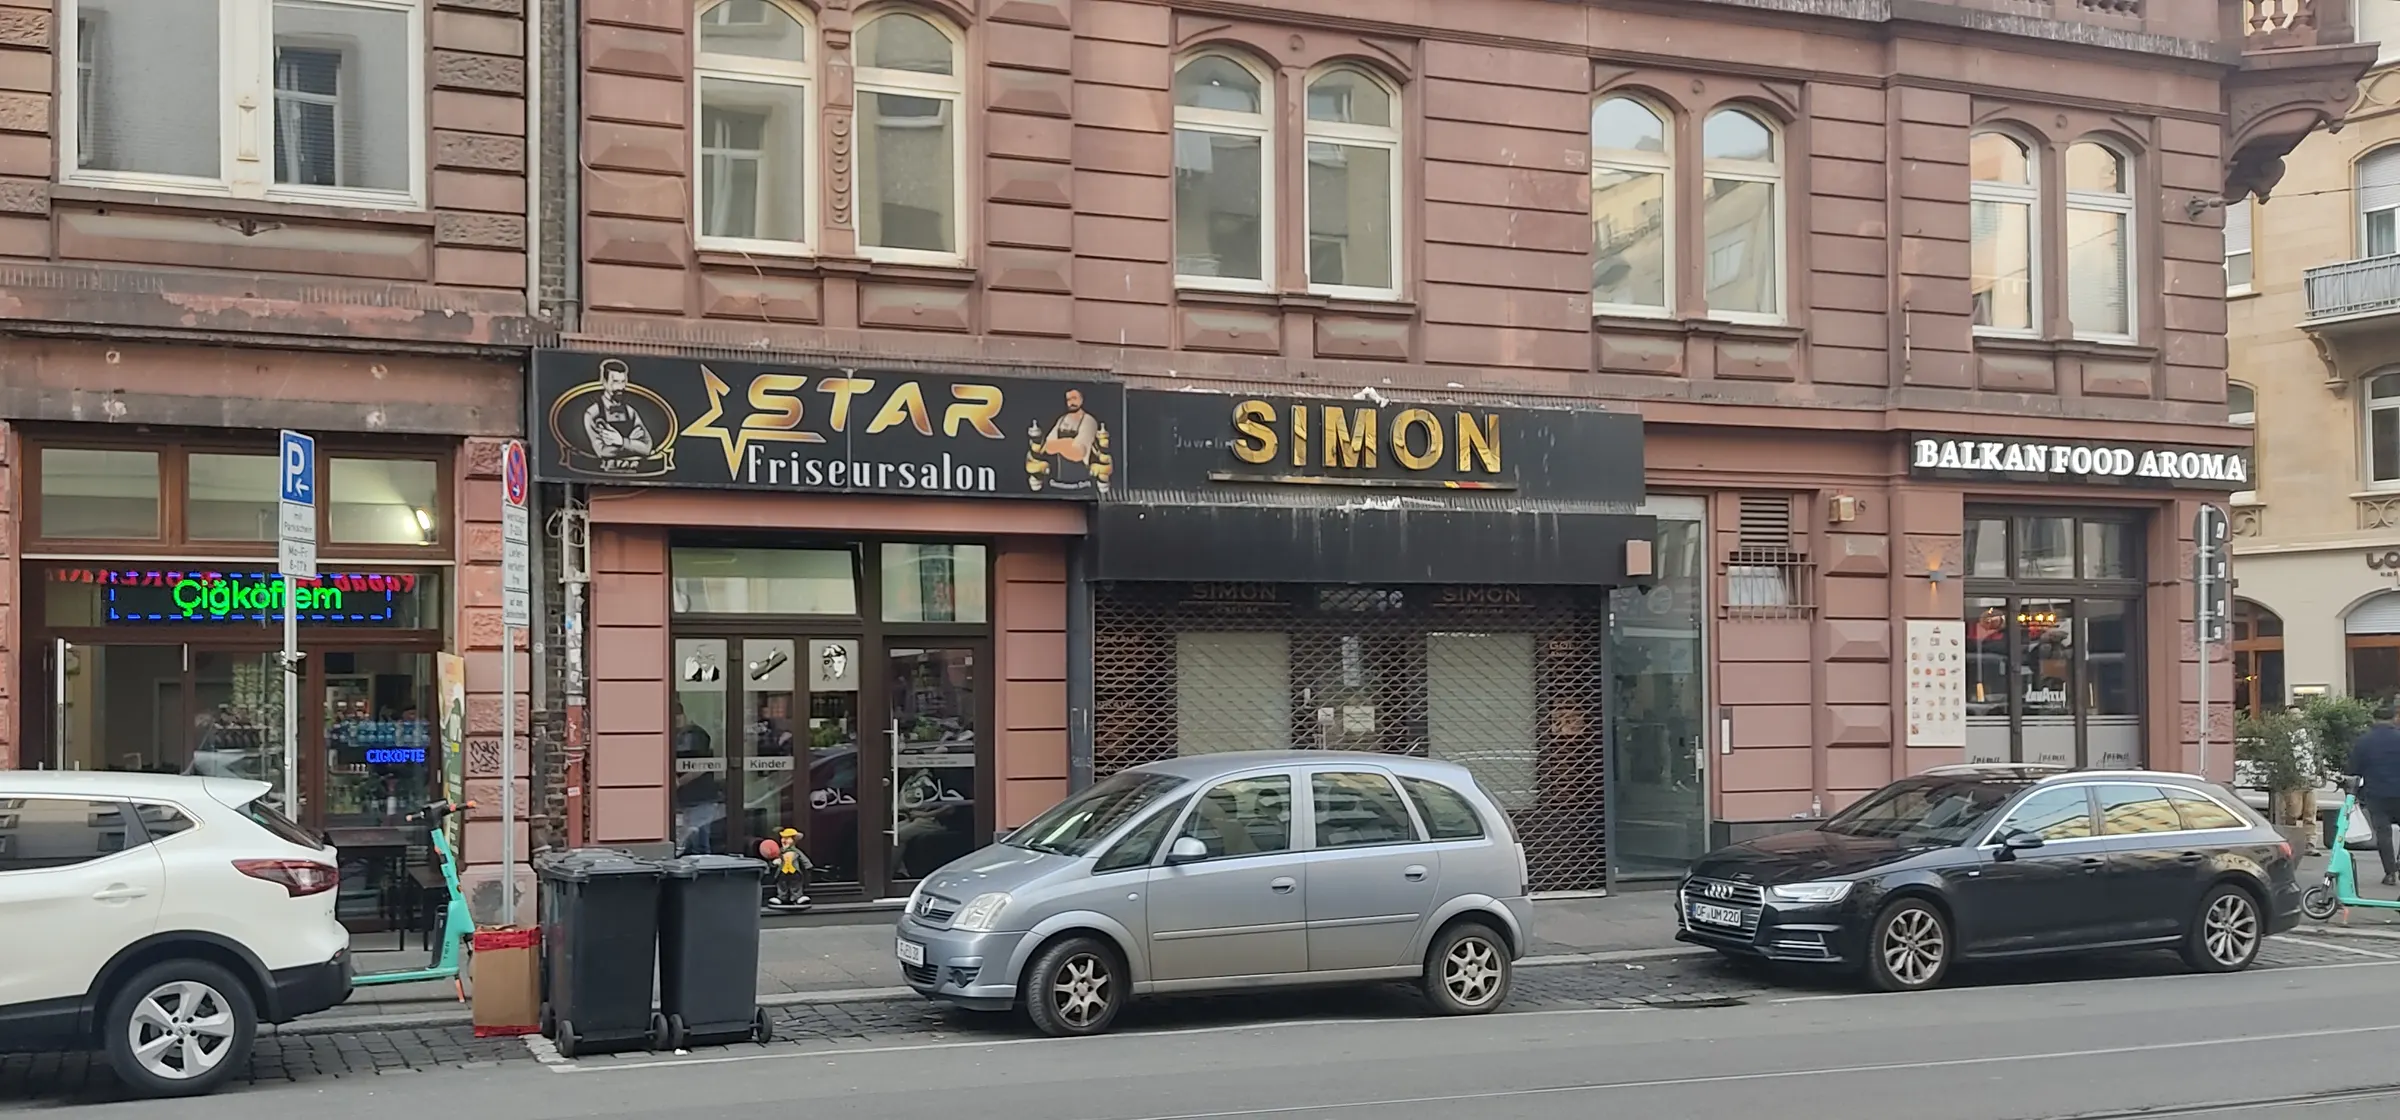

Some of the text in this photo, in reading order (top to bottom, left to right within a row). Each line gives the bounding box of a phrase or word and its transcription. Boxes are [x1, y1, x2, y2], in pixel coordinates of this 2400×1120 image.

[743, 373, 1005, 439] STAR
[1232, 399, 1501, 473] SIMON
[287, 441, 305, 493] P
[748, 444, 997, 491] Friseursalon
[1914, 439, 2247, 483] BALKAN FOOD AROMA
[1192, 582, 1277, 601] SIMON
[1442, 586, 1521, 603] SIMON
[682, 760, 722, 770] Herren
[750, 759, 787, 770] Kinder
[1723, 910, 1740, 924] 220
